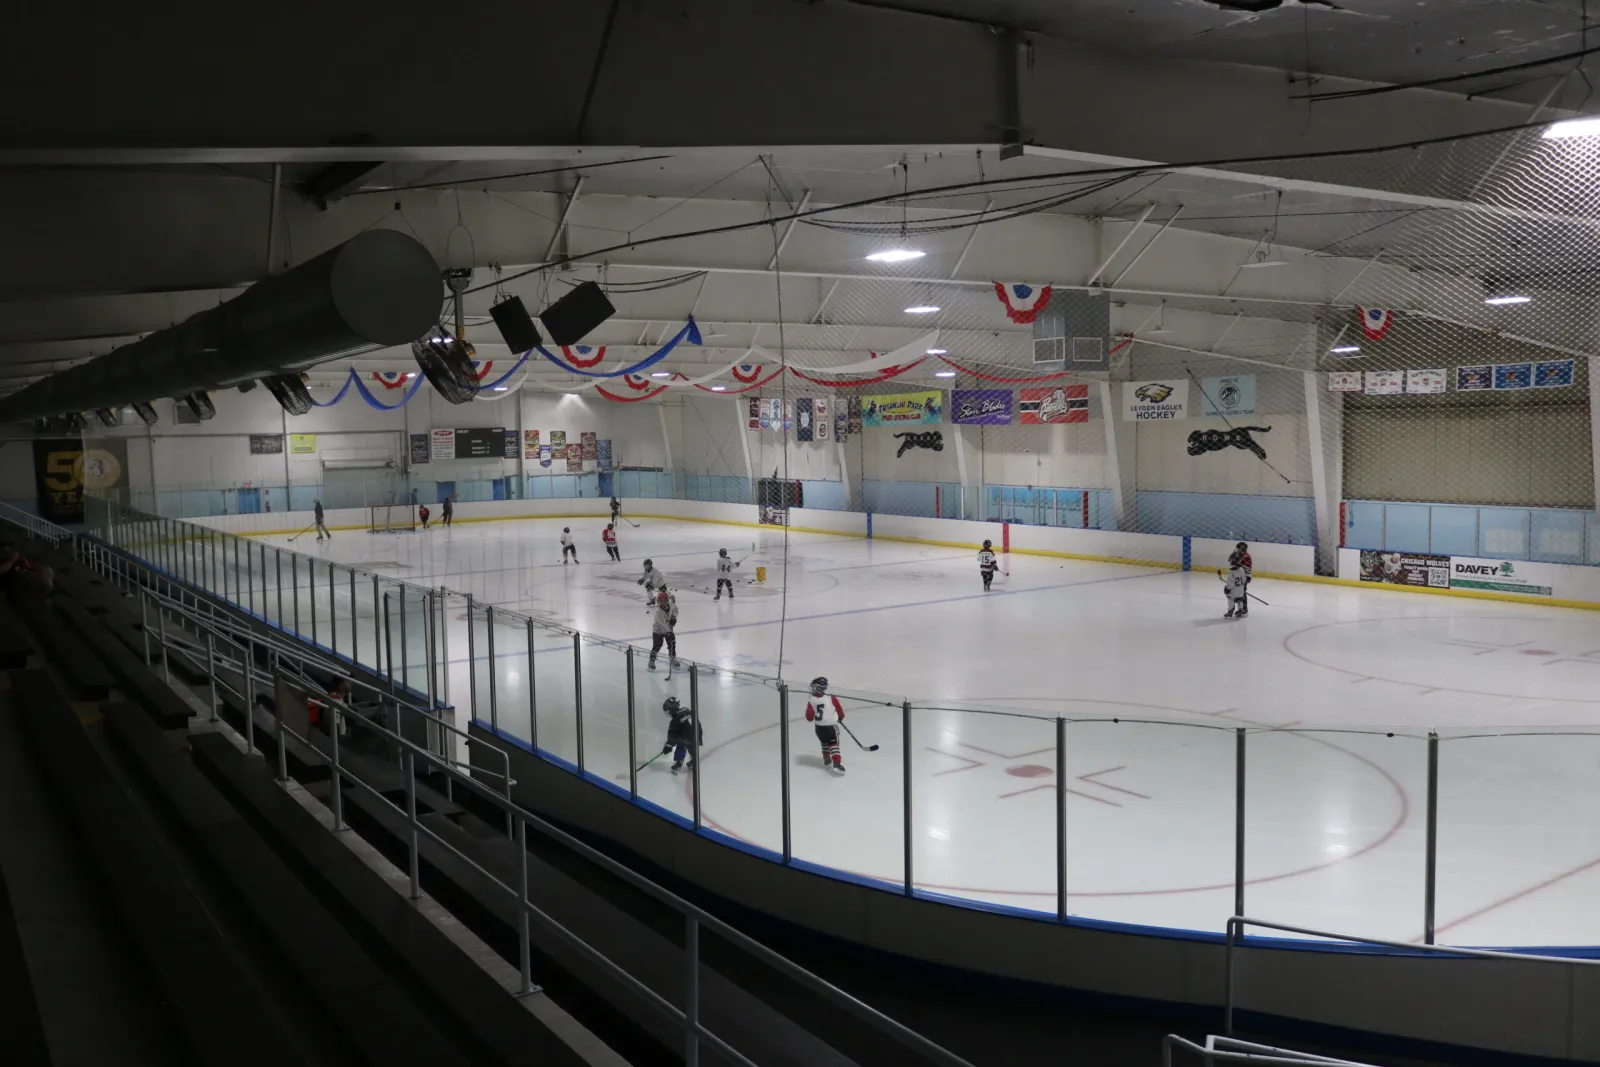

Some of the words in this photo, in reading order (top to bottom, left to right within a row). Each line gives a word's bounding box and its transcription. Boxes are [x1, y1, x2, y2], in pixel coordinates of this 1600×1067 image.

[1136, 411, 1176, 420] HOCKEY
[1400, 558, 1425, 566] CHICAGO
[721, 564, 731, 572] 44
[1455, 564, 1499, 576] DAVEY
[1235, 577, 1243, 586] 21
[815, 704, 824, 721] 5
